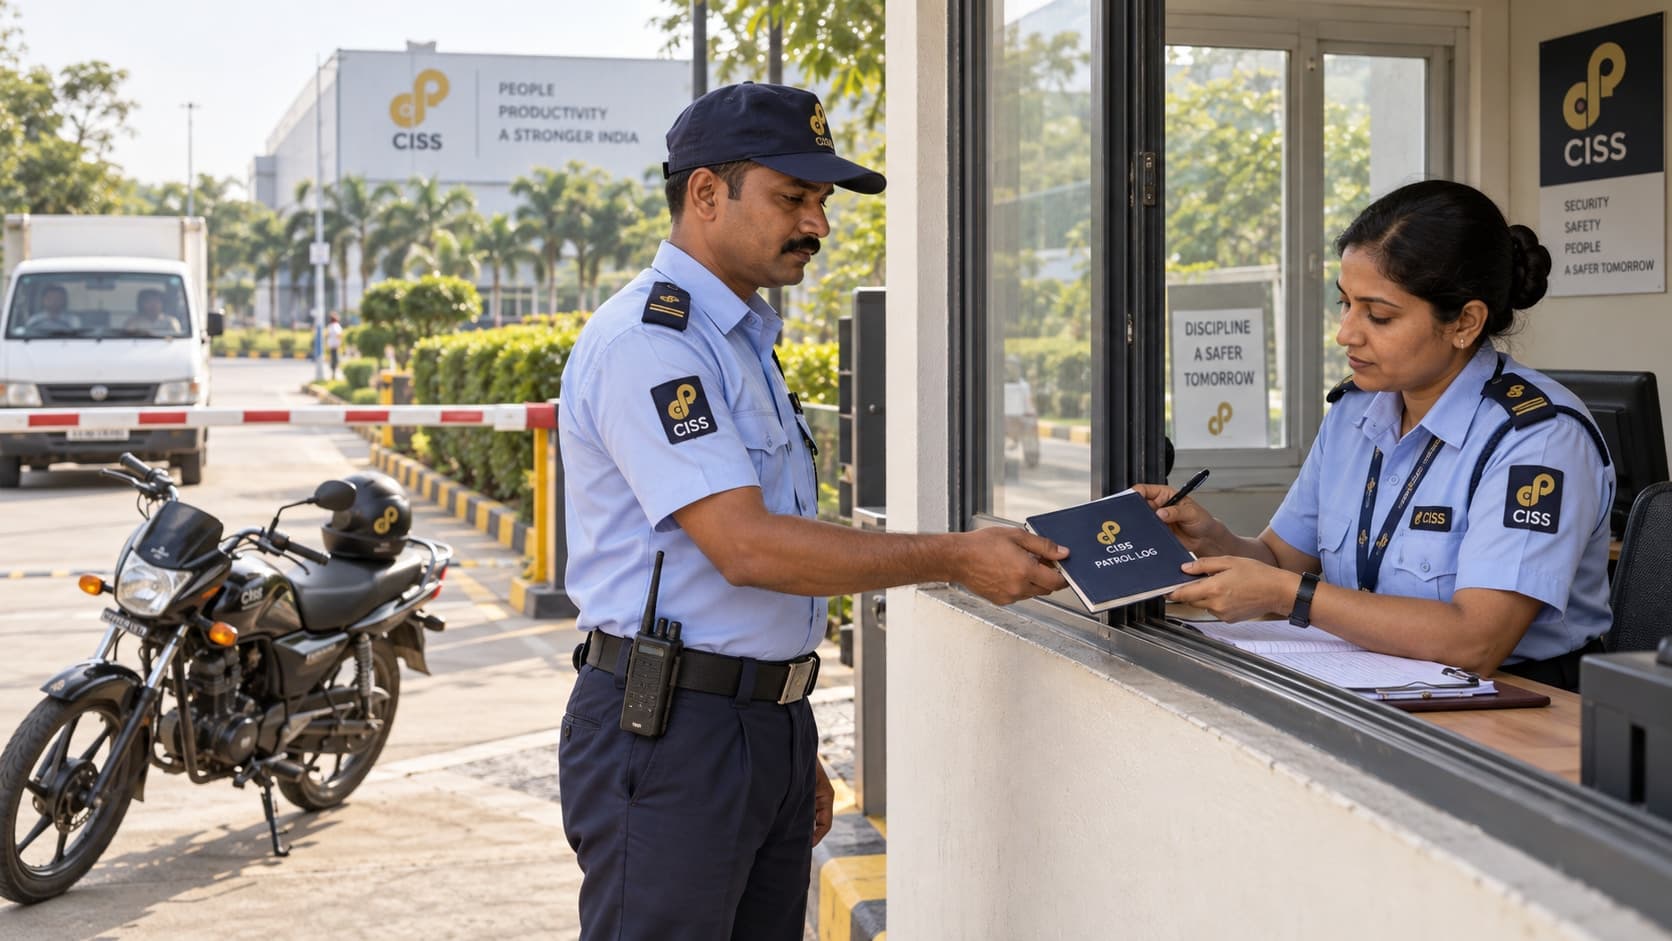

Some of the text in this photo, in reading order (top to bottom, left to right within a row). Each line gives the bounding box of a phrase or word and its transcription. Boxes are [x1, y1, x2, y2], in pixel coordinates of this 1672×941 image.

[499, 82, 555, 97] PEOPLE
[499, 105, 608, 120] PRODUCTIVITY
[392, 132, 443, 150] CISS
[499, 128, 639, 144] A STRONGER INDIA
[1564, 131, 1627, 167] CISS
[1564, 196, 1610, 212] SECURITY
[1564, 219, 1601, 234] SAFETY
[1564, 240, 1601, 255] PEOPLE
[1564, 259, 1655, 275] A SAFER TOMORROW
[1185, 319, 1251, 336] DISCIPLINE
[1194, 345, 1243, 361] A SAFER
[1184, 370, 1255, 387] TOMORROW
[673, 416, 709, 437] CISS
[1422, 511, 1446, 525] CISS
[1512, 509, 1551, 527] CISS
[1095, 547, 1158, 569] PATROL LOG
